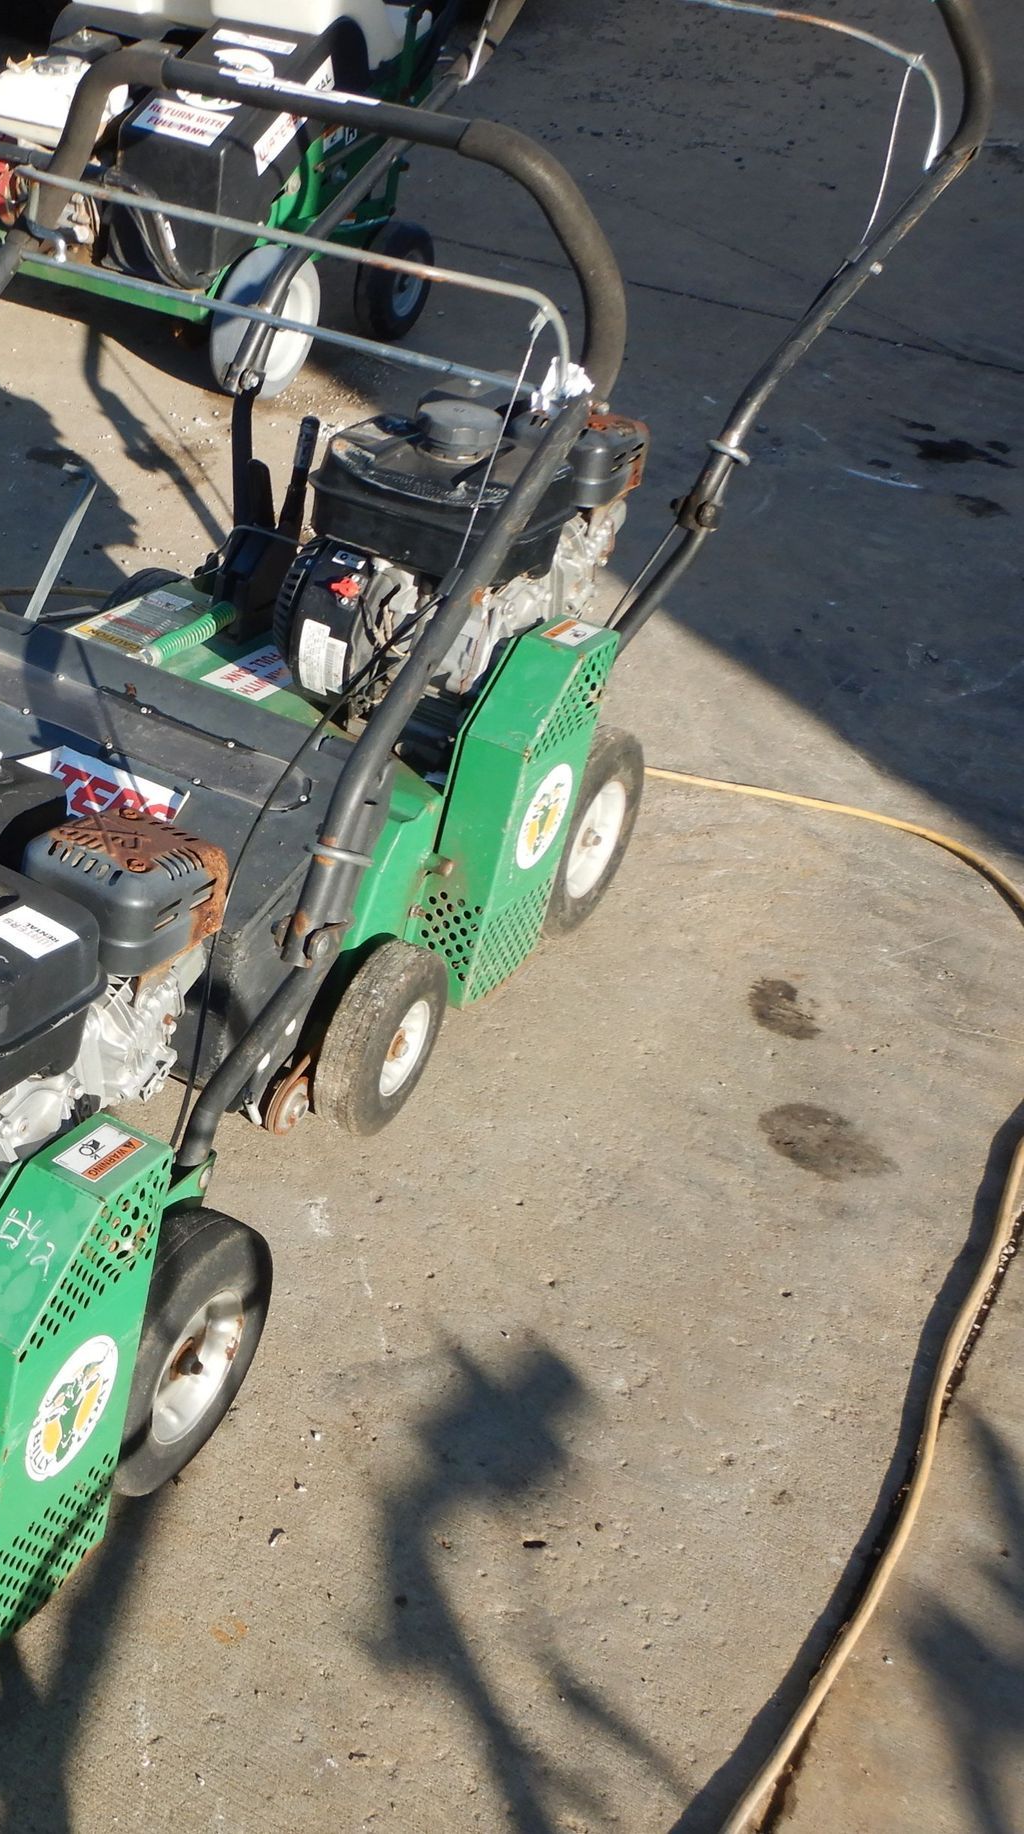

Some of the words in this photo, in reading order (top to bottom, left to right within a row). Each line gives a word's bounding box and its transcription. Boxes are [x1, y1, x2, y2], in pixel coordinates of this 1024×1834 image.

[147, 115, 174, 129] FULL
[176, 123, 208, 137] TANK
[148, 103, 195, 121] RETURN
[196, 115, 226, 129] WITH
[256, 652, 282, 668] FULL
[220, 662, 259, 684] TANK
[88, 1148, 128, 1177] WARNING
